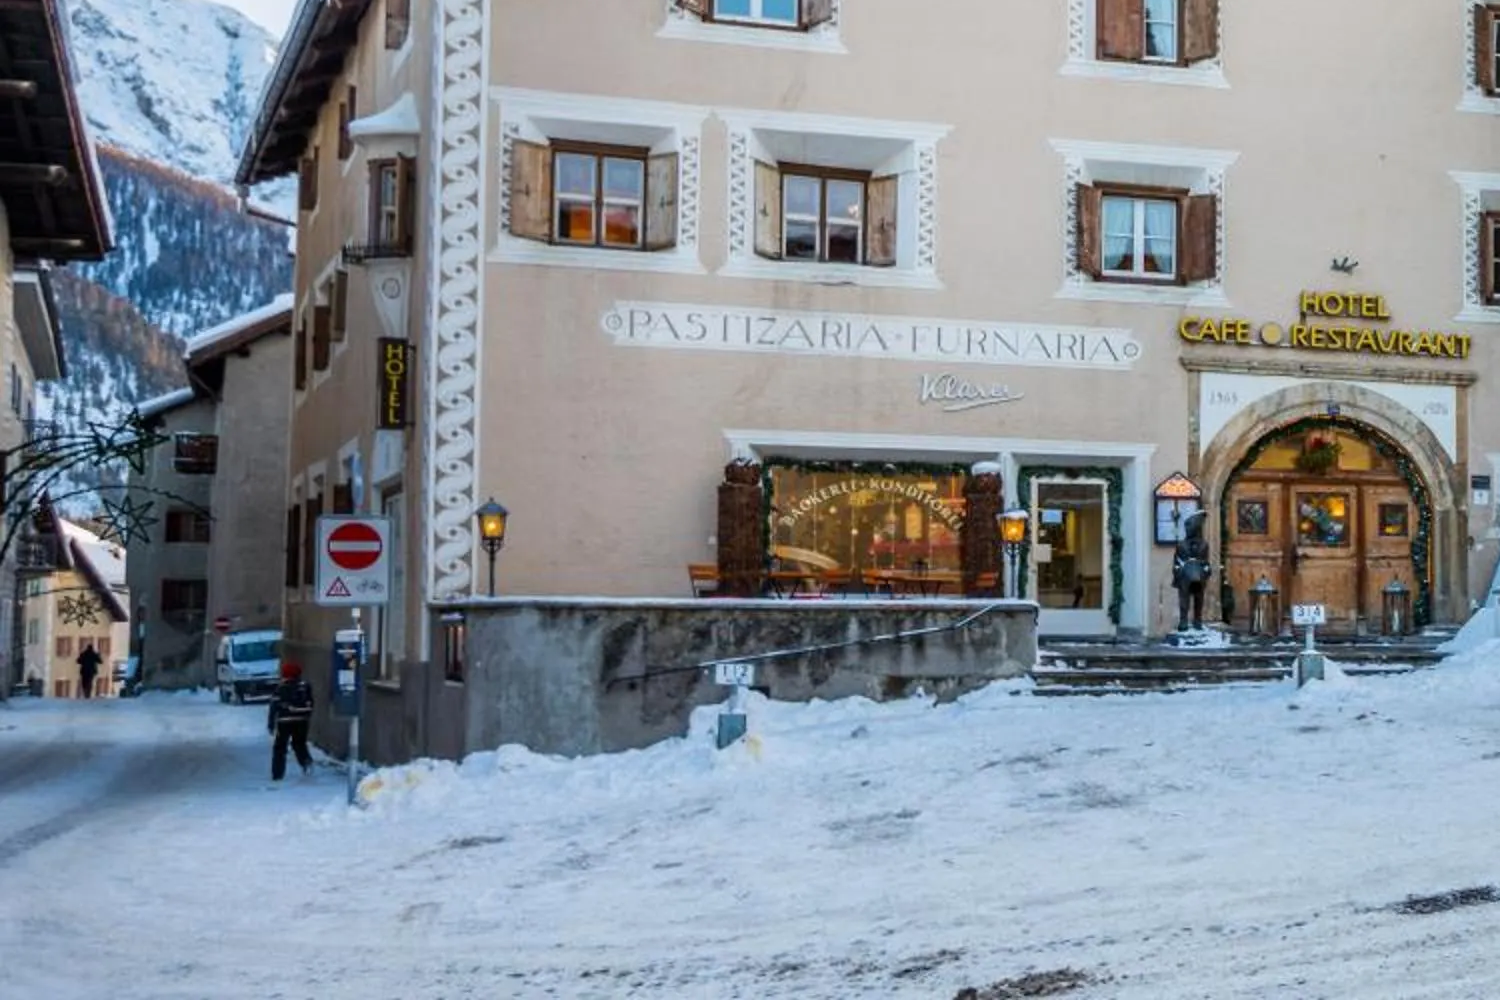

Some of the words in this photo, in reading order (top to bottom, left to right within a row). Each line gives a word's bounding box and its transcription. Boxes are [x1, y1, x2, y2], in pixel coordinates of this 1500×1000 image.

[1301, 293, 1391, 319] HOTEL
[628, 309, 889, 351] PASTIZARIA
[910, 325, 1120, 363] FURNARIA
[1179, 318, 1251, 343] CAFE
[1291, 323, 1471, 359] RESTAURANT
[385, 343, 404, 424] HOTEL
